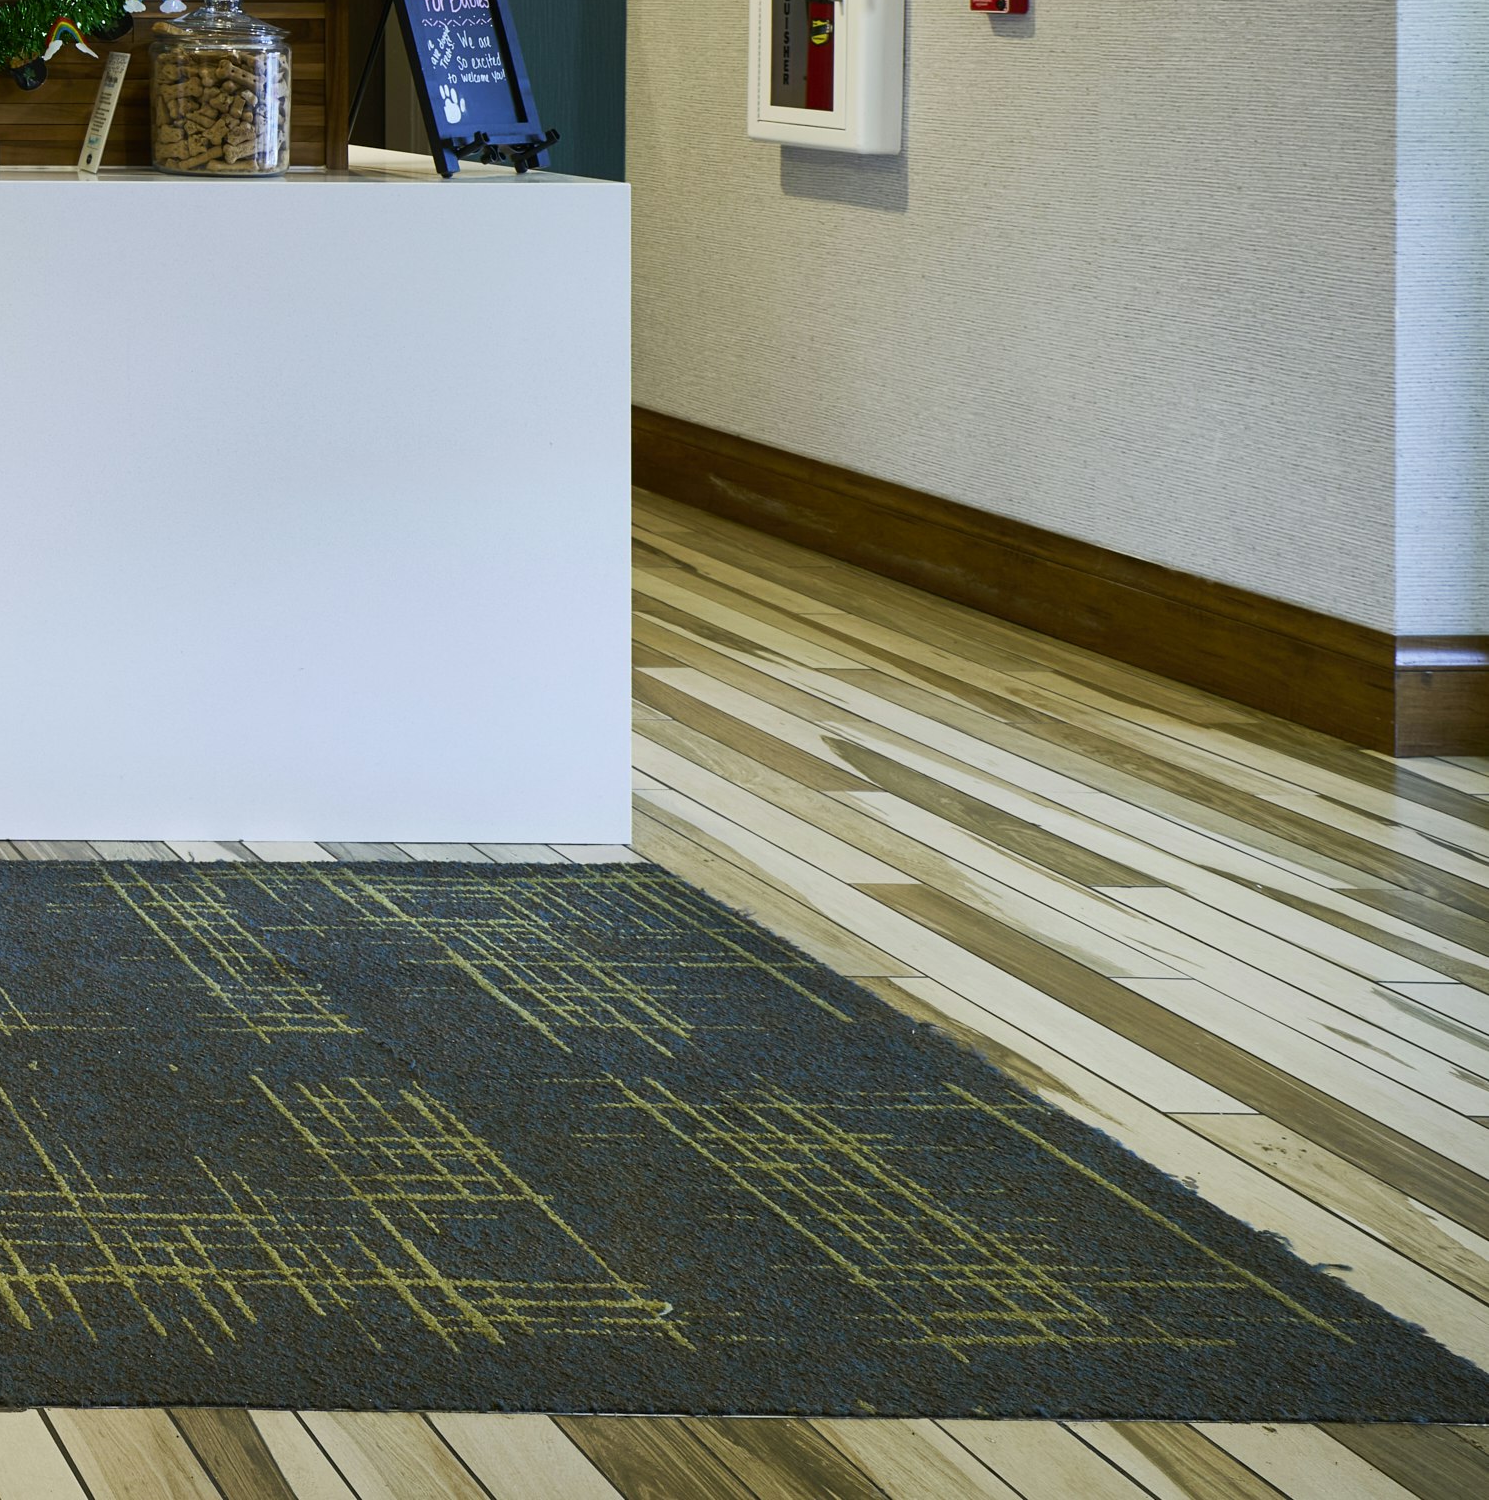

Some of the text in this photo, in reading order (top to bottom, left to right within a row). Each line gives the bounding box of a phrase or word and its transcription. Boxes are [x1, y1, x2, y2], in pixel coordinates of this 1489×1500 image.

[457, 30, 492, 49] We are
[471, 52, 501, 69] excited
[448, 73, 458, 84] to
[461, 72, 490, 83] welcome
